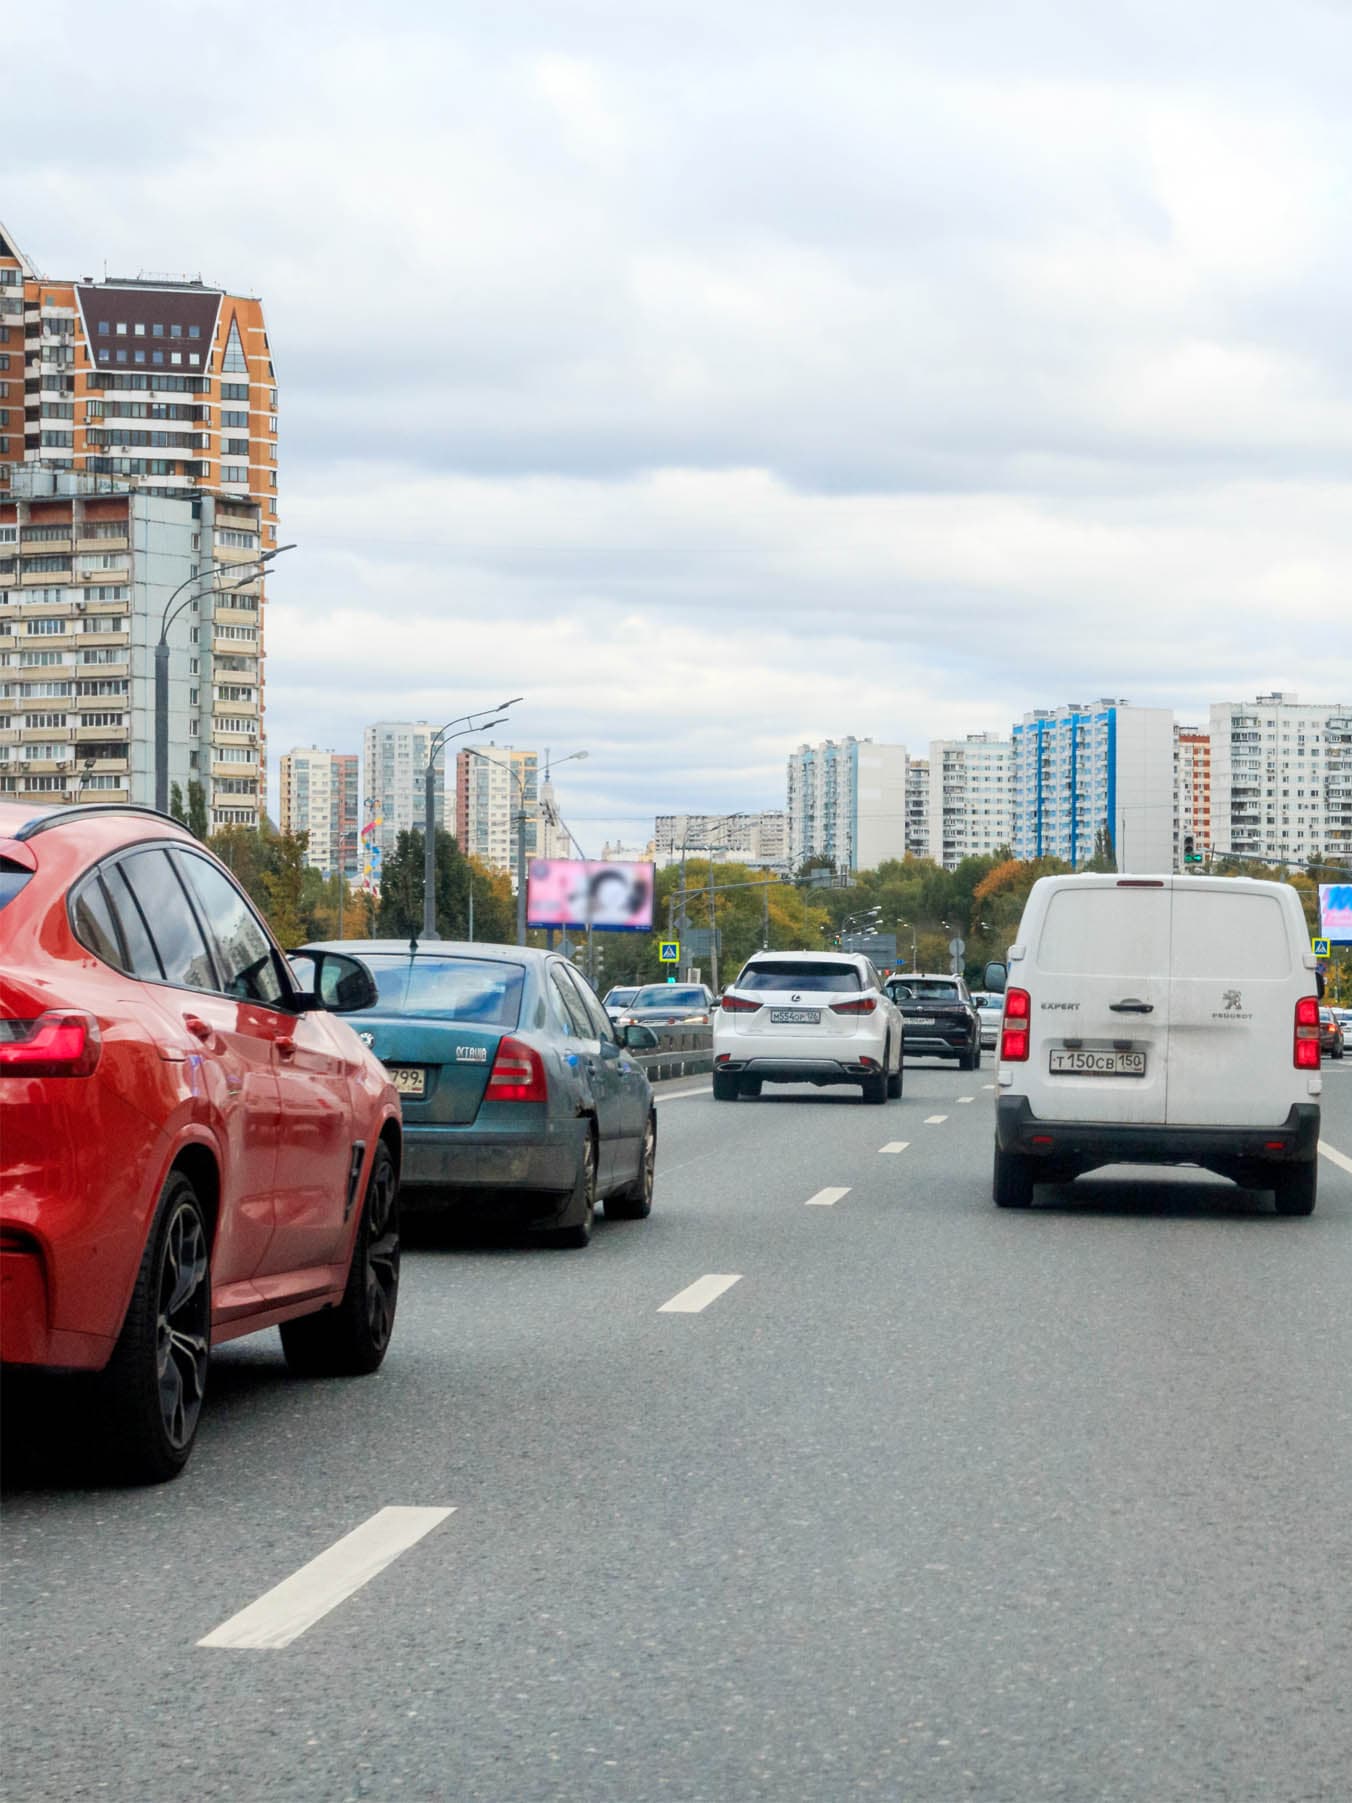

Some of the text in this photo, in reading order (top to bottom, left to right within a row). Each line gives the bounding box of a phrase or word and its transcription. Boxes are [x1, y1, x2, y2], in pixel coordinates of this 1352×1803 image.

[1041, 1002, 1080, 1011] EXPERT
[456, 1046, 487, 1059] OCTAVIA
[391, 1070, 419, 1085] 799
